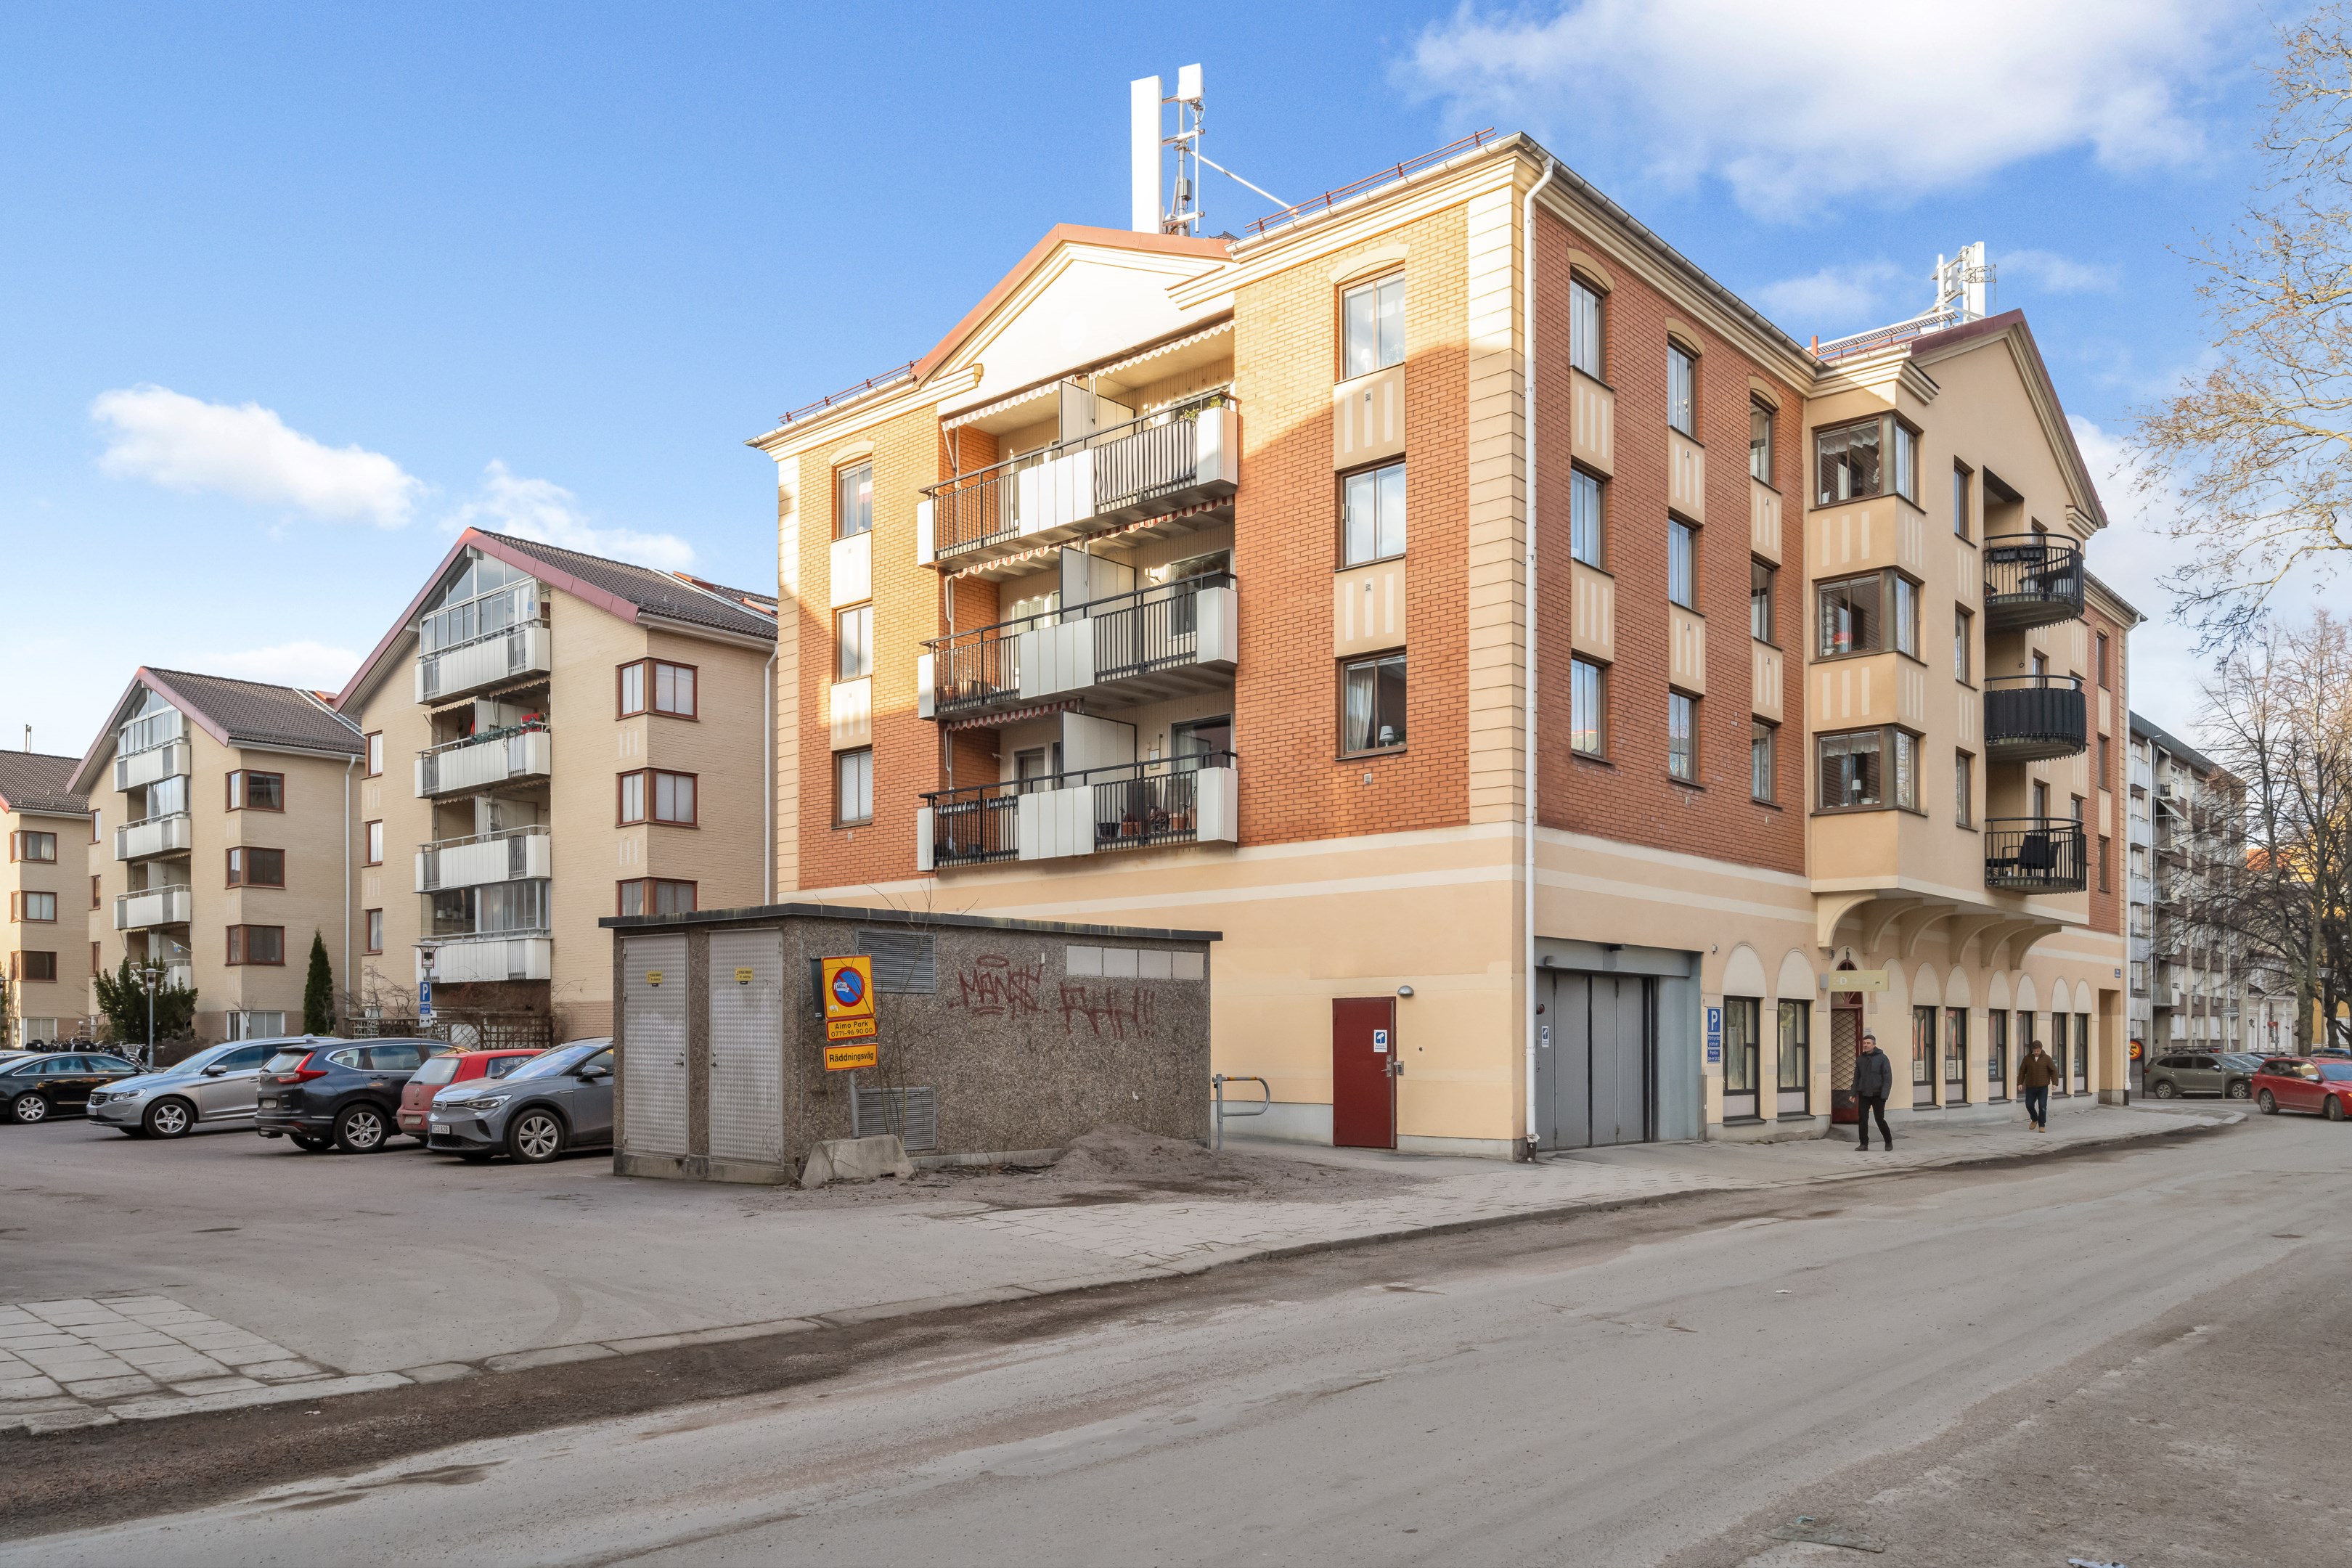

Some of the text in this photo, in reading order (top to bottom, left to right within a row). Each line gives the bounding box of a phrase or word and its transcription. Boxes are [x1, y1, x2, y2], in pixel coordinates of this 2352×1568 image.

[1846, 947, 1850, 960] 6
[423, 984, 428, 1000] P
[1711, 1010, 1718, 1031] P
[829, 1051, 874, 1063] Räddningsväg
